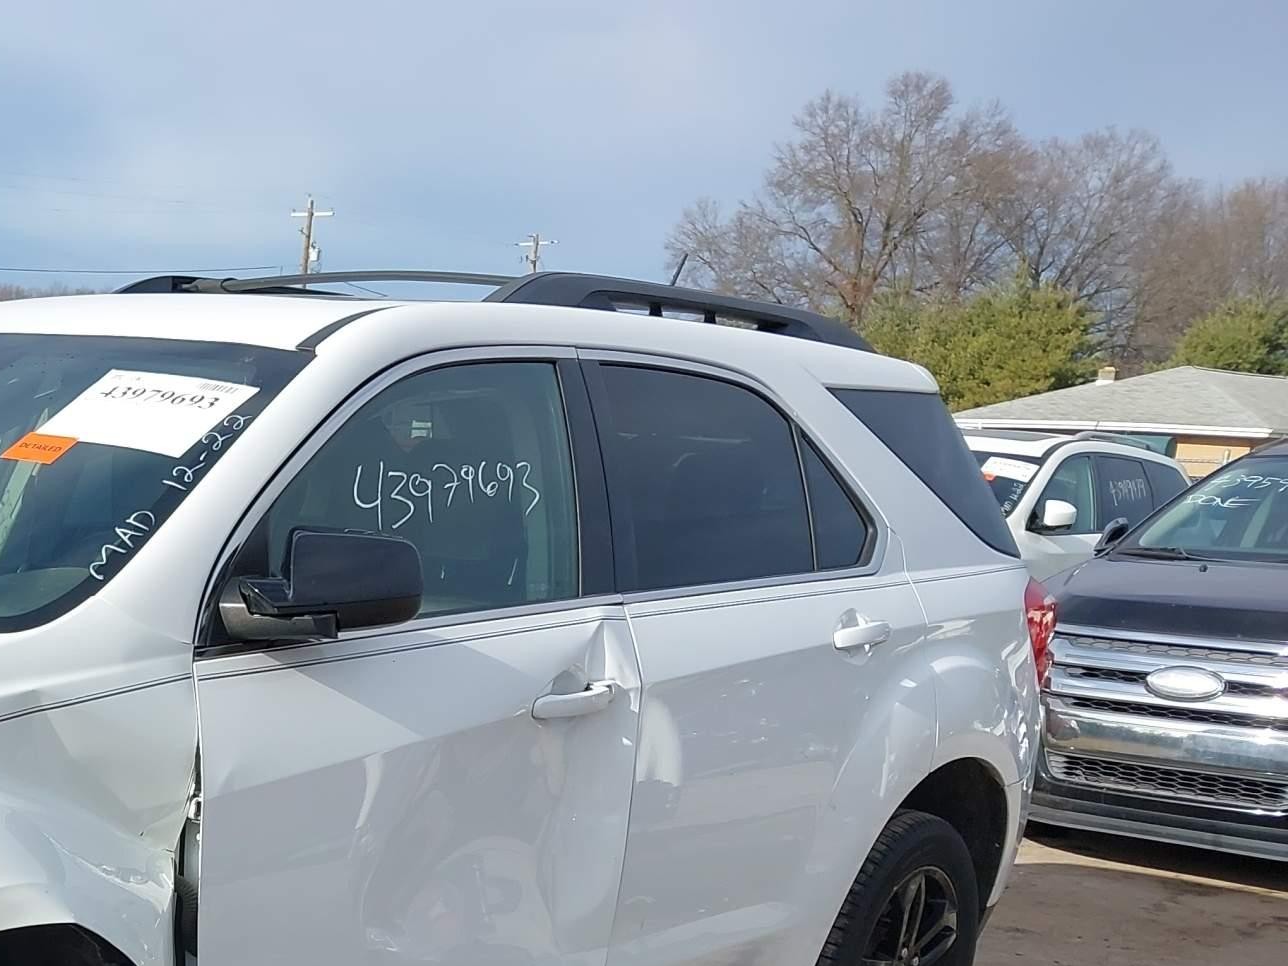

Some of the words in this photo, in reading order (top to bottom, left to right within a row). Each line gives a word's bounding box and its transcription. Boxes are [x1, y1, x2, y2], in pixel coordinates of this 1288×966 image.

[100, 385, 220, 410] 43979693
[19, 442, 62, 453] DETAILED
[89, 510, 156, 580] MAD
[162, 414, 253, 491] 12-22
[353, 460, 541, 531] 43979693
